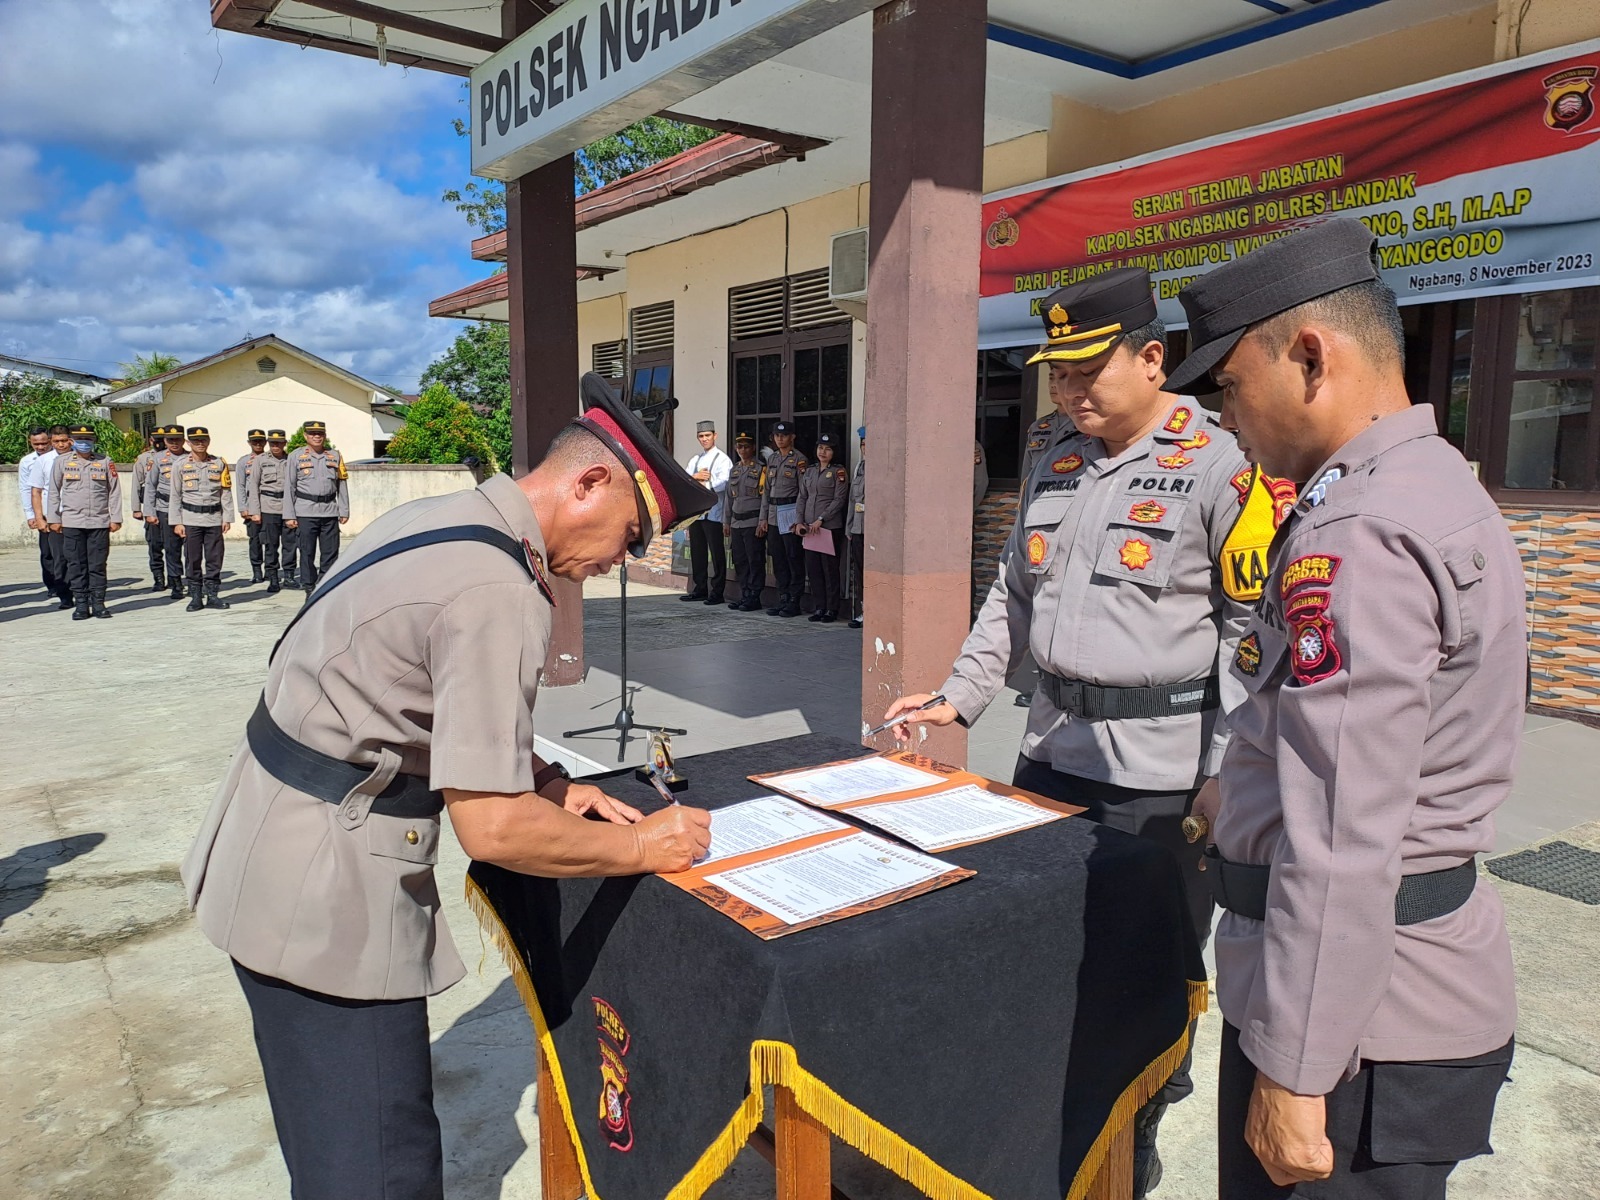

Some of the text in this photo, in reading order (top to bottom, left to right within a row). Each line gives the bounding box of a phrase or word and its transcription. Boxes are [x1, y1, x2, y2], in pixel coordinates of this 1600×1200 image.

[481, 15, 588, 147] POLSEK
[1086, 173, 1416, 256] KAPOLSEK NGABANG POLRES LANDAK
[1133, 154, 1344, 218] SERAH TERIMA JABATAN
[1014, 271, 1047, 293] DARI
[1163, 241, 1231, 271] KOMPOL
[1413, 202, 1456, 231] S.H,
[1462, 188, 1532, 222] M.A.P
[1409, 253, 1593, 291] Ngabang, 8 November 2023
[1128, 477, 1195, 493] POLRI
[596, 1001, 625, 1041] POLRES
